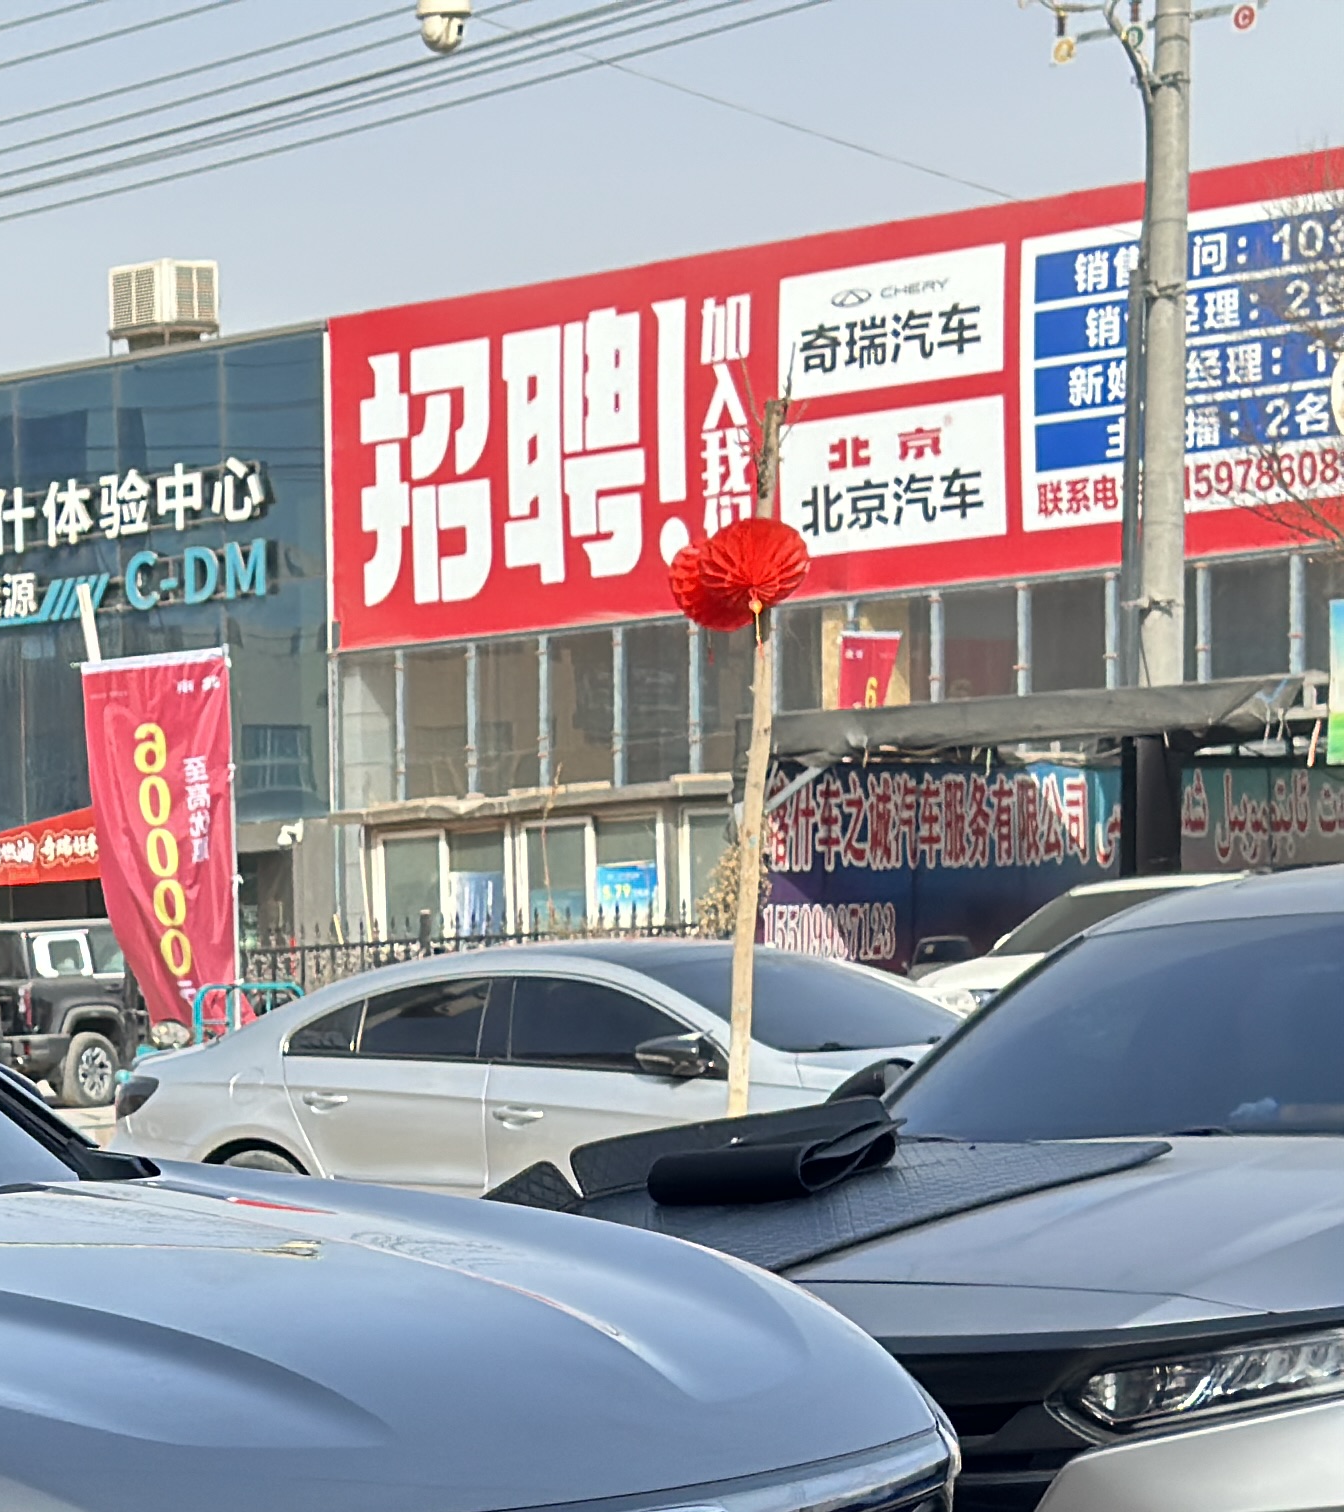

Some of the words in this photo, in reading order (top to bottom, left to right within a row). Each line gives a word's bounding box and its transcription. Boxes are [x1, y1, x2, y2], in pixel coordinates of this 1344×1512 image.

[880, 278, 949, 298] CHERY
[799, 303, 981, 373] 奇瑞汽车
[828, 427, 942, 470] 北京
[801, 467, 983, 536] 北京汽车
[125, 538, 266, 610] C-DM
